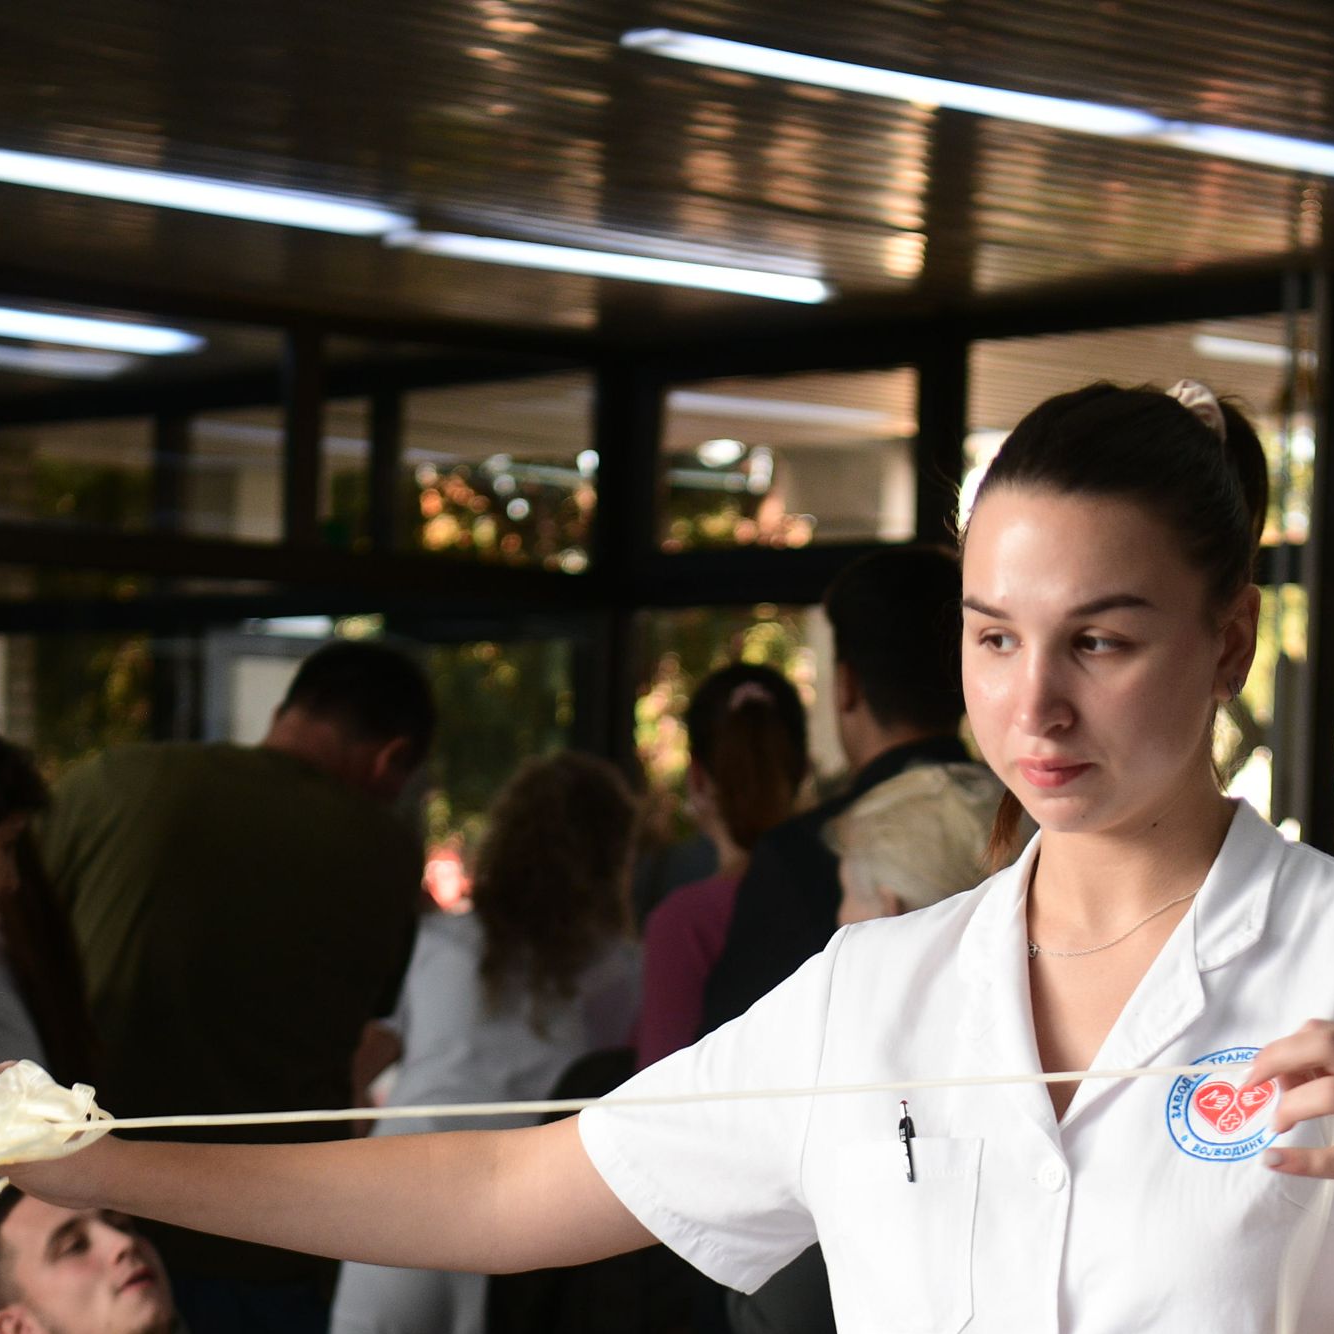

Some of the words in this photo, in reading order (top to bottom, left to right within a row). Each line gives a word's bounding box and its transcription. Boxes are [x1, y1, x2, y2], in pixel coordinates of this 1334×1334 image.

[1171, 1077, 1195, 1119] ЗАВОД
[1209, 1051, 1256, 1065] ТРАНС
[1192, 1134, 1266, 1157] ВОЈВОДИНЕ
